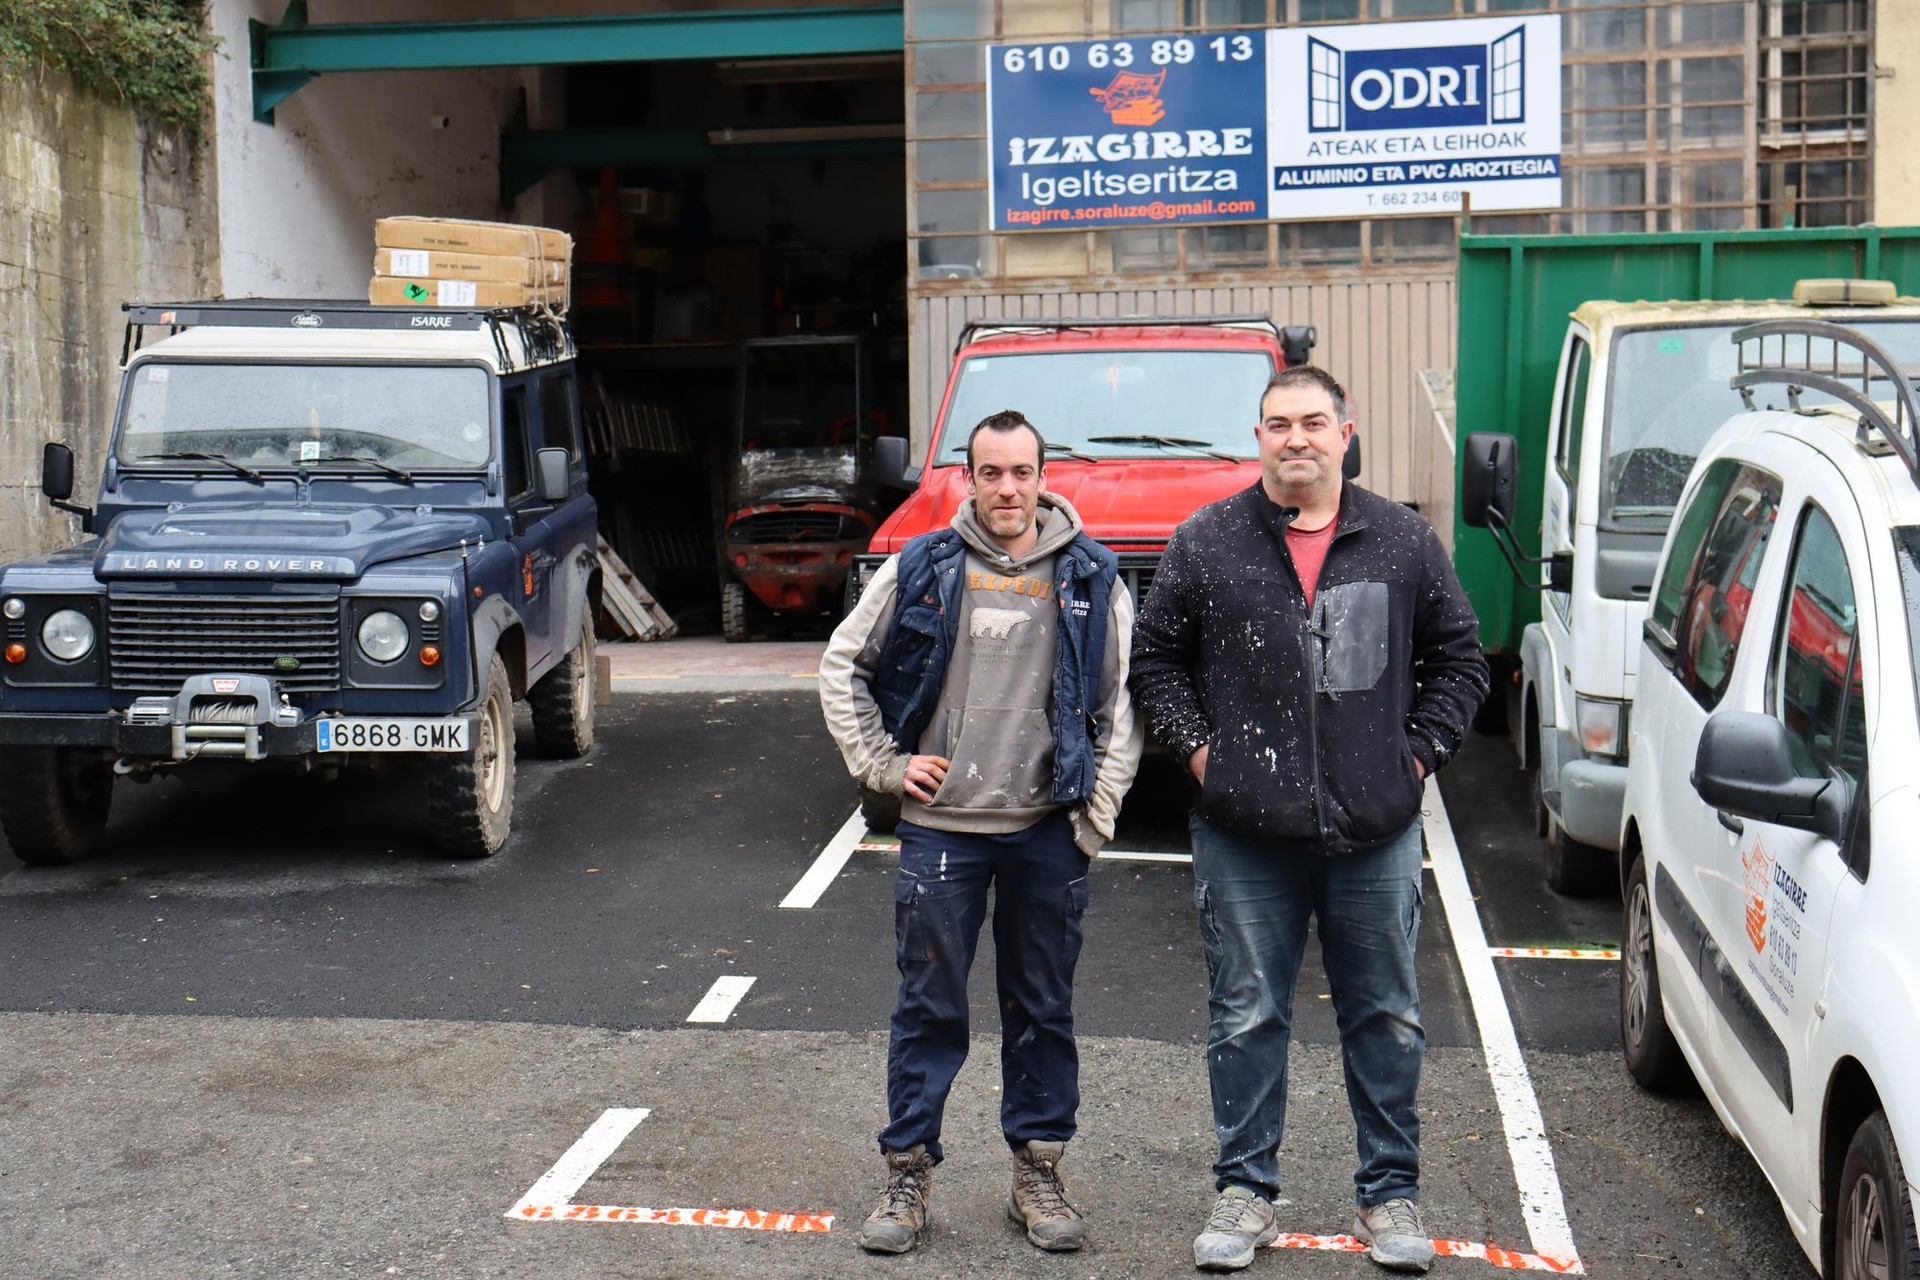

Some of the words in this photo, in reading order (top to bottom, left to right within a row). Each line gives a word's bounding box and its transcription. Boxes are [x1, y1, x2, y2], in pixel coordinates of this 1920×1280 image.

[1004, 46, 1070, 73] 610
[1087, 42, 1134, 68] 63
[1151, 39, 1195, 65] 89
[1210, 36, 1253, 62] 13
[1350, 64, 1481, 111] ODRI
[1307, 138, 1377, 157] ATEAK
[1384, 136, 1427, 153] ETA
[1433, 131, 1527, 152] LEIHOAK
[1278, 166, 1368, 186] ALUMINIO
[1372, 166, 1405, 183] ETA
[1409, 163, 1446, 181] PVC
[1449, 159, 1556, 178] AROZTEGIA
[1022, 166, 1238, 206] Igeltseritza
[1382, 193, 1408, 205] 662
[1412, 191, 1438, 204] 234
[1007, 200, 1256, 225] izagirre.soraluze@gmail.com
[411, 316, 452, 328] ISARRE
[123, 558, 204, 570] LAND
[224, 559, 325, 571] ROVER
[968, 571, 1054, 600] EXPEDI
[334, 723, 401, 747] 6868
[413, 724, 462, 748] GMK
